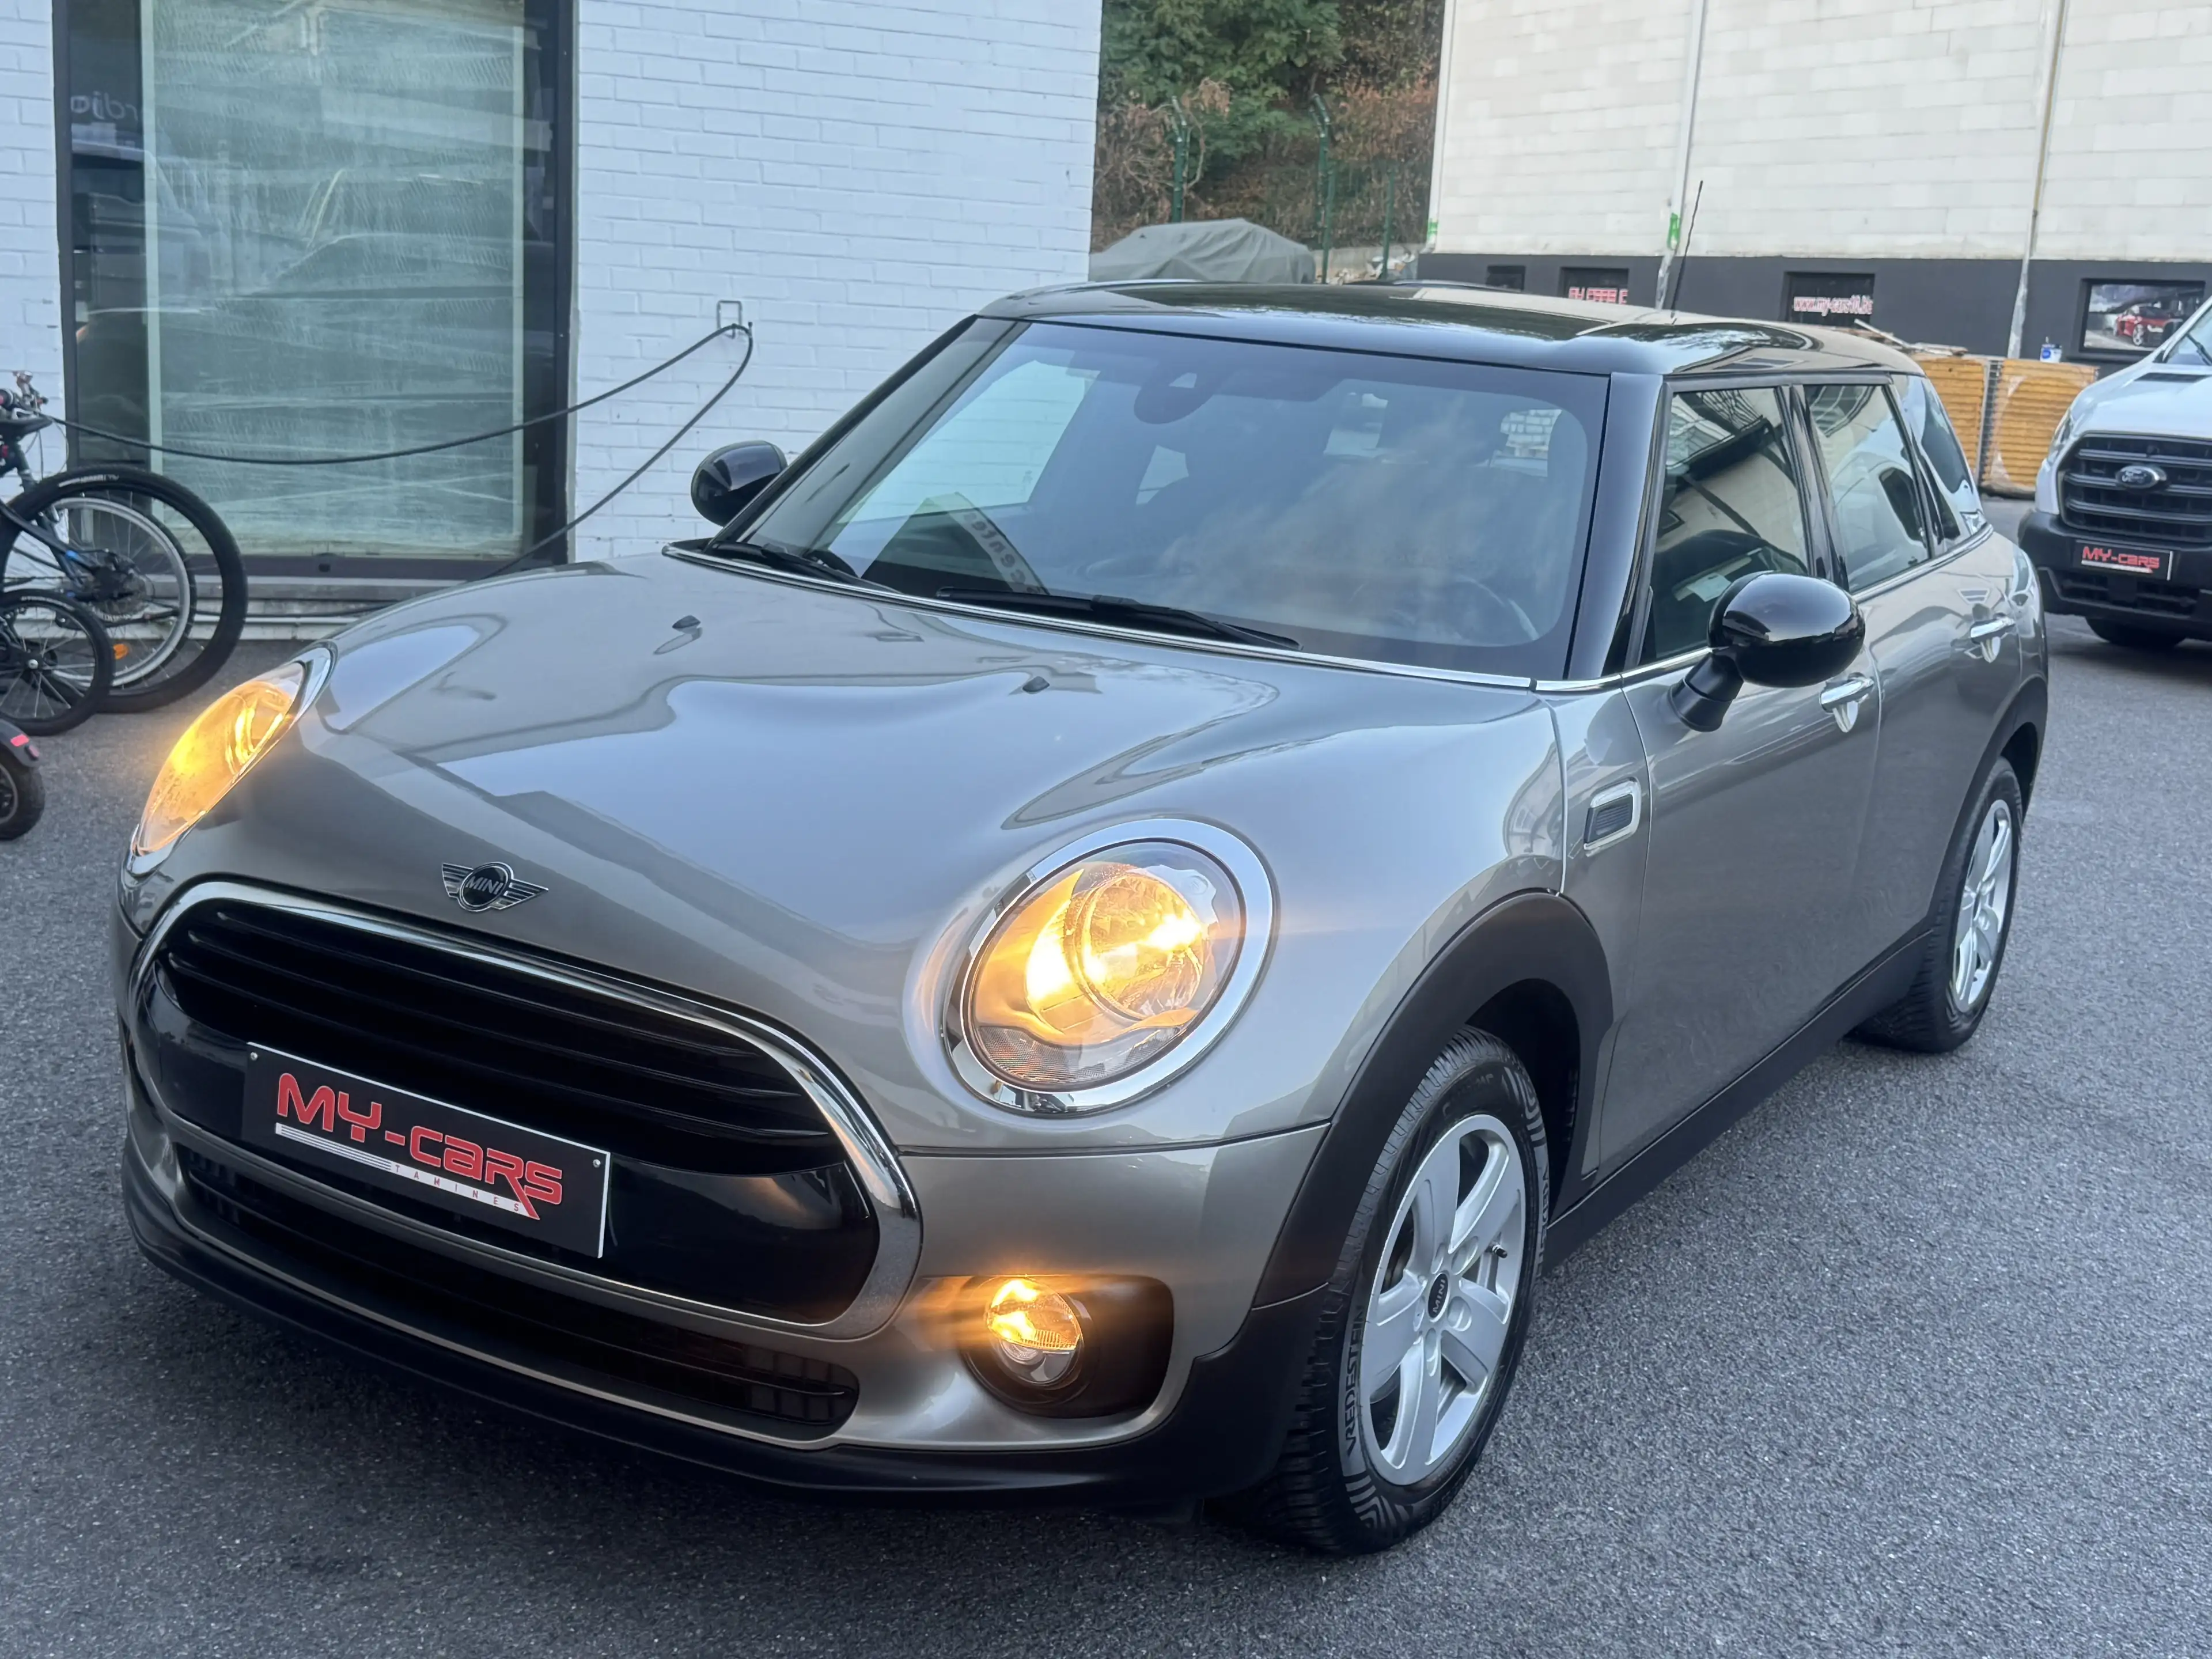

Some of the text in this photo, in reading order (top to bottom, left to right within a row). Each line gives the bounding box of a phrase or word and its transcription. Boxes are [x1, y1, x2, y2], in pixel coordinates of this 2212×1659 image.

[465, 876, 504, 895] MINI
[395, 1164, 520, 1211] TAMINES
[1433, 1279, 1446, 1313] MINI
[1344, 1305, 1364, 1456] VREDESTEIN
